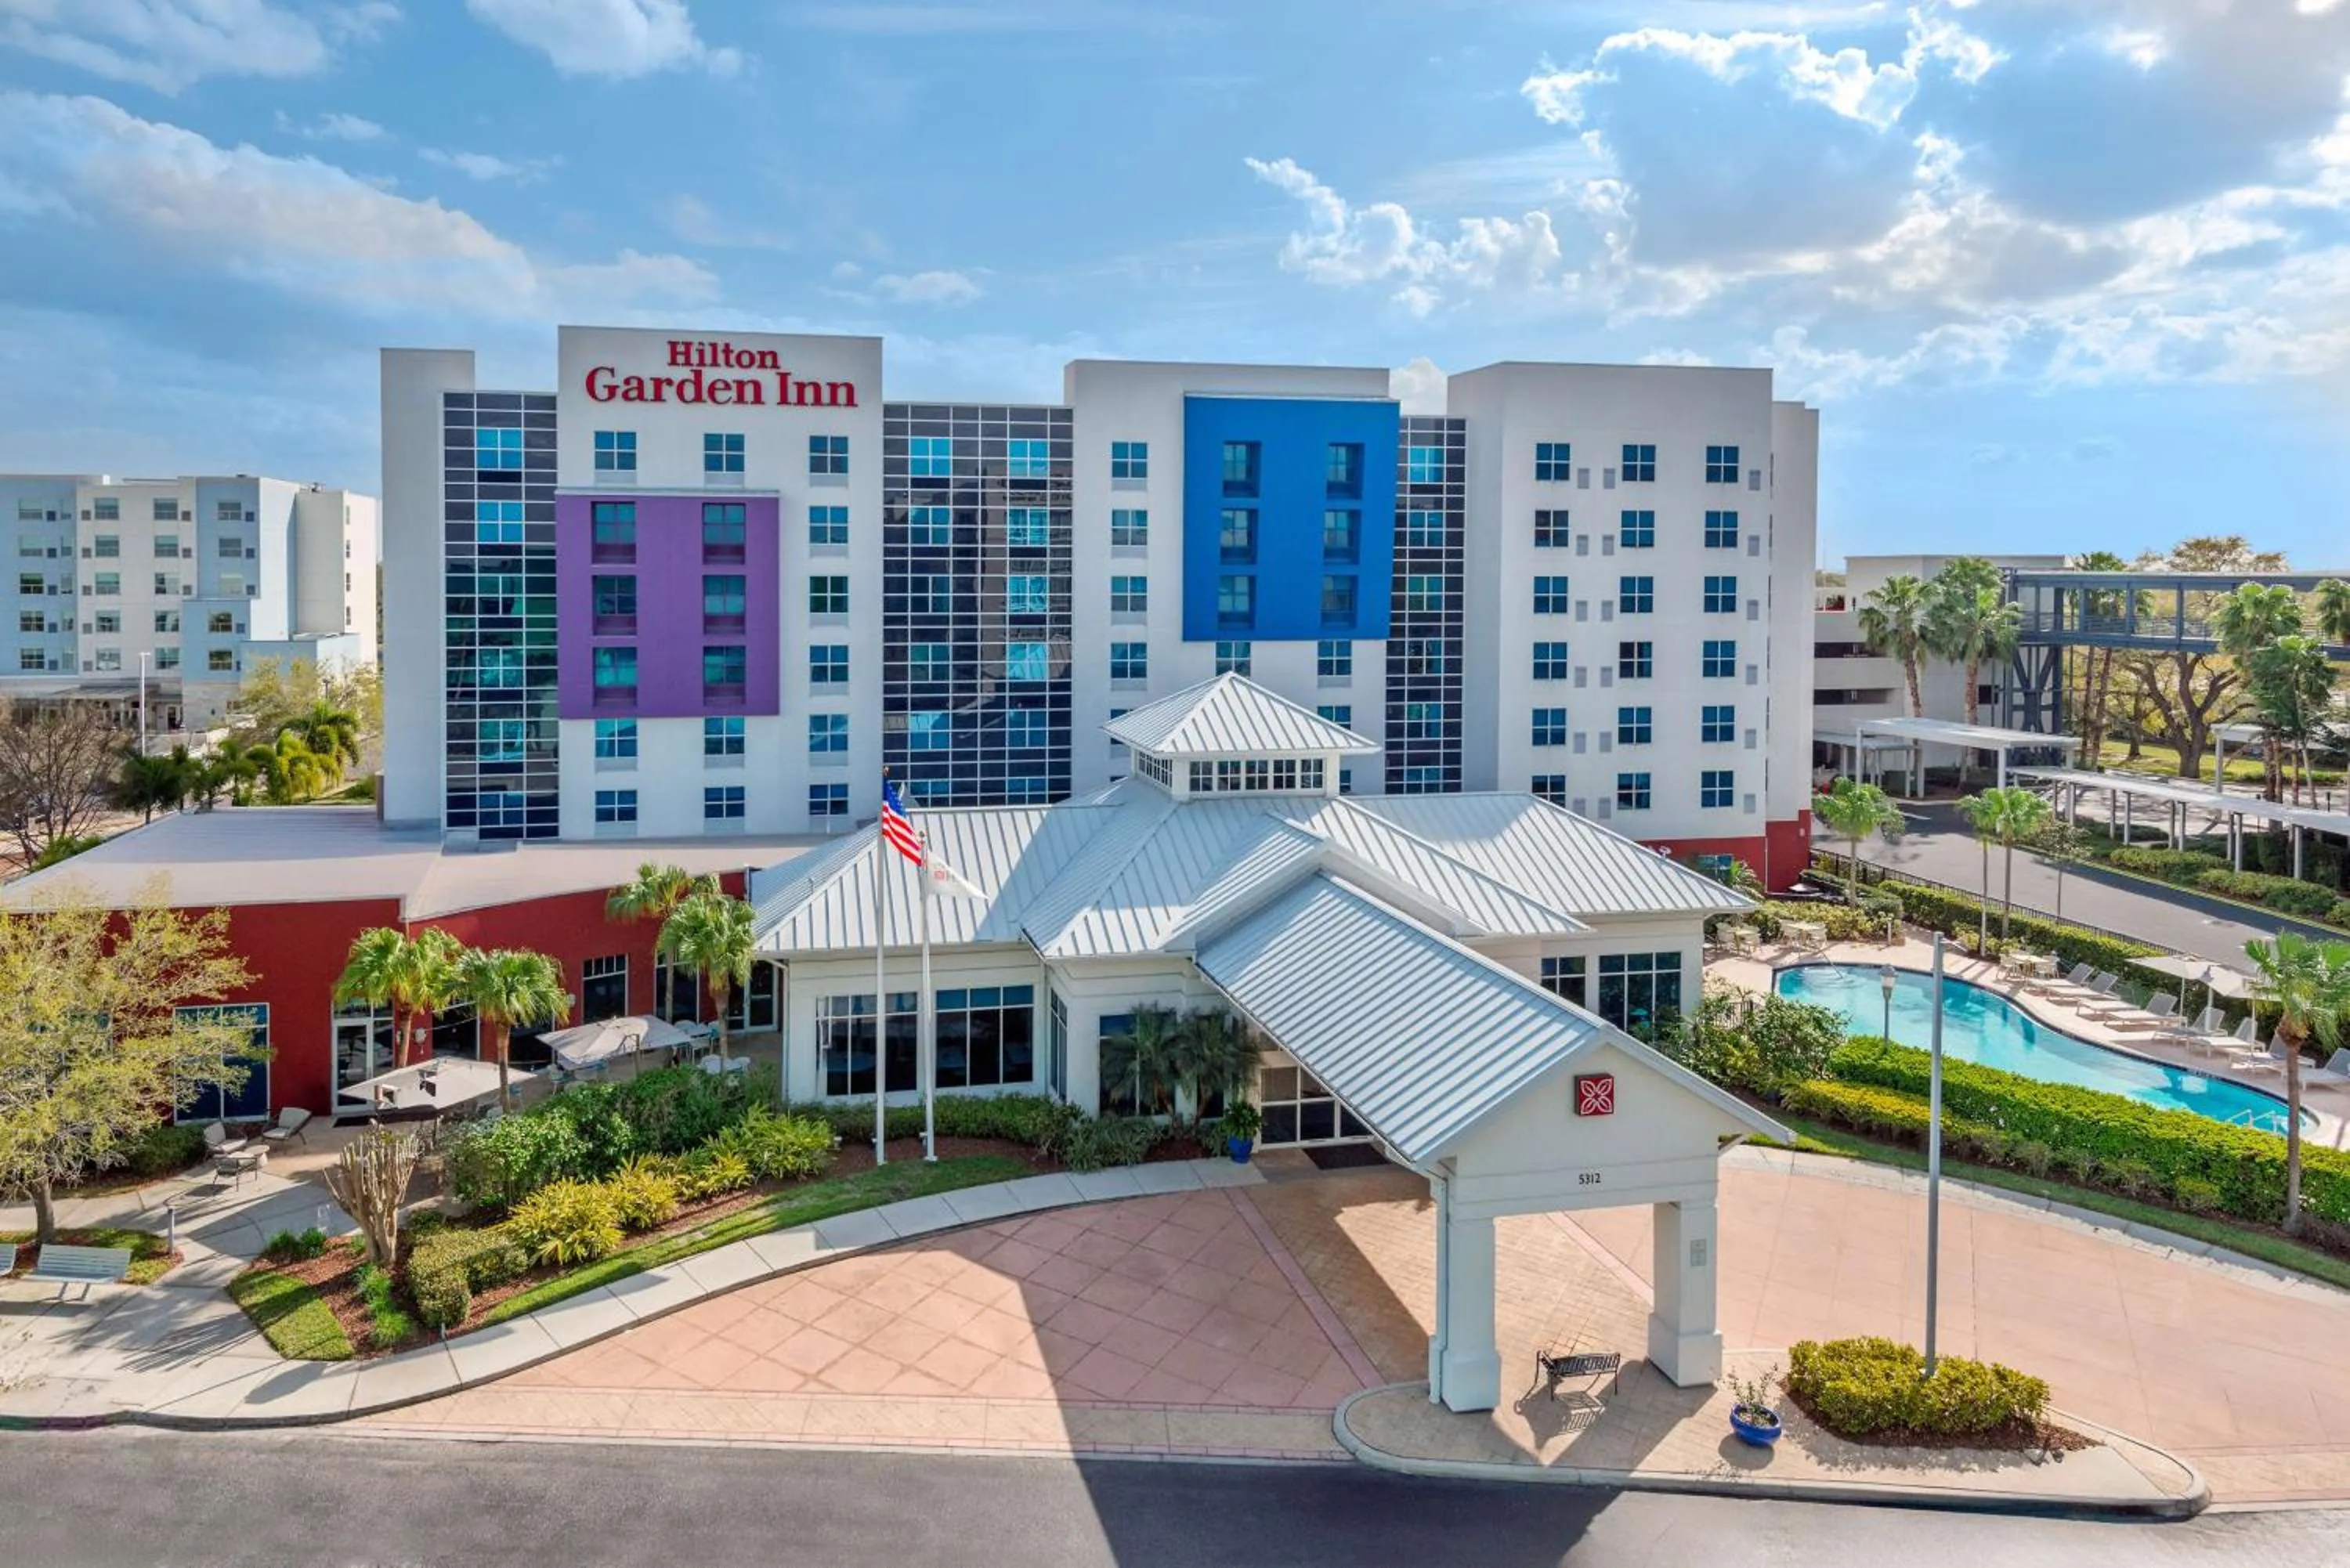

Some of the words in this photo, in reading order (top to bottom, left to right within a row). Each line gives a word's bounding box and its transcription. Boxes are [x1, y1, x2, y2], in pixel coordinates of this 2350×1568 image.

[667, 340, 781, 369] Hilton
[585, 366, 766, 405] Garden
[776, 371, 859, 407] Inn
[1578, 1172, 1601, 1185] 5312
